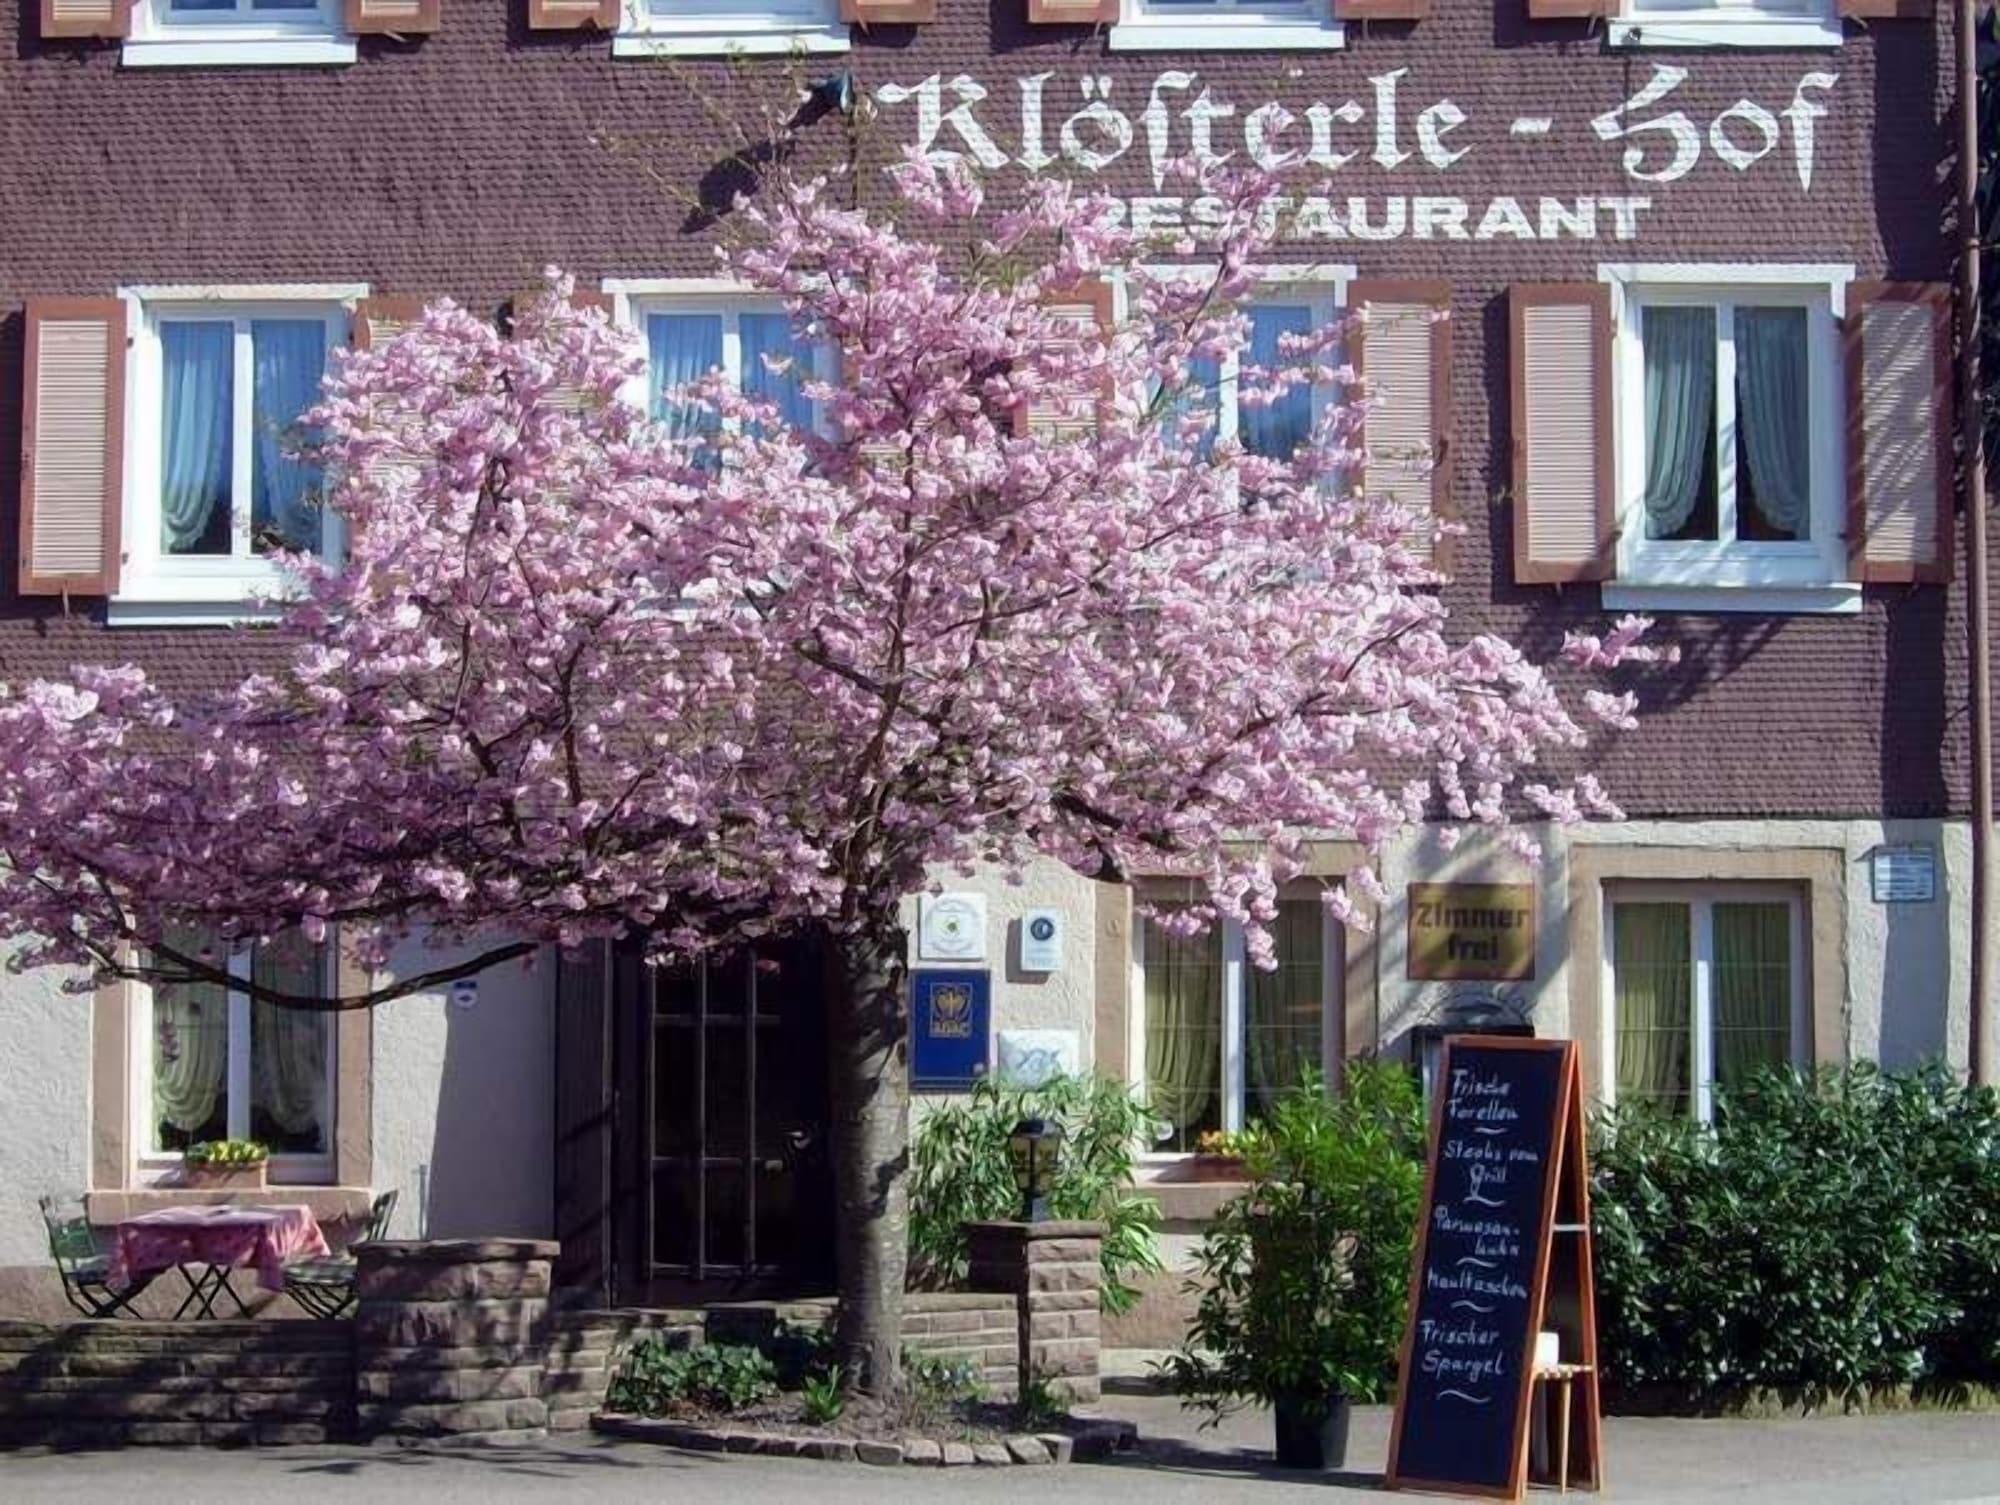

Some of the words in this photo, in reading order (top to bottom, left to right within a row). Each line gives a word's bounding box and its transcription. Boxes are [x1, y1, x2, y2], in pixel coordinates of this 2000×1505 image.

[1590, 63, 1840, 193] Hof
[1416, 902, 1531, 929] Zimmer
[1447, 933, 1499, 961] frei
[1420, 1318, 1500, 1346] Frischer
[1421, 1349, 1504, 1384] Spargel
